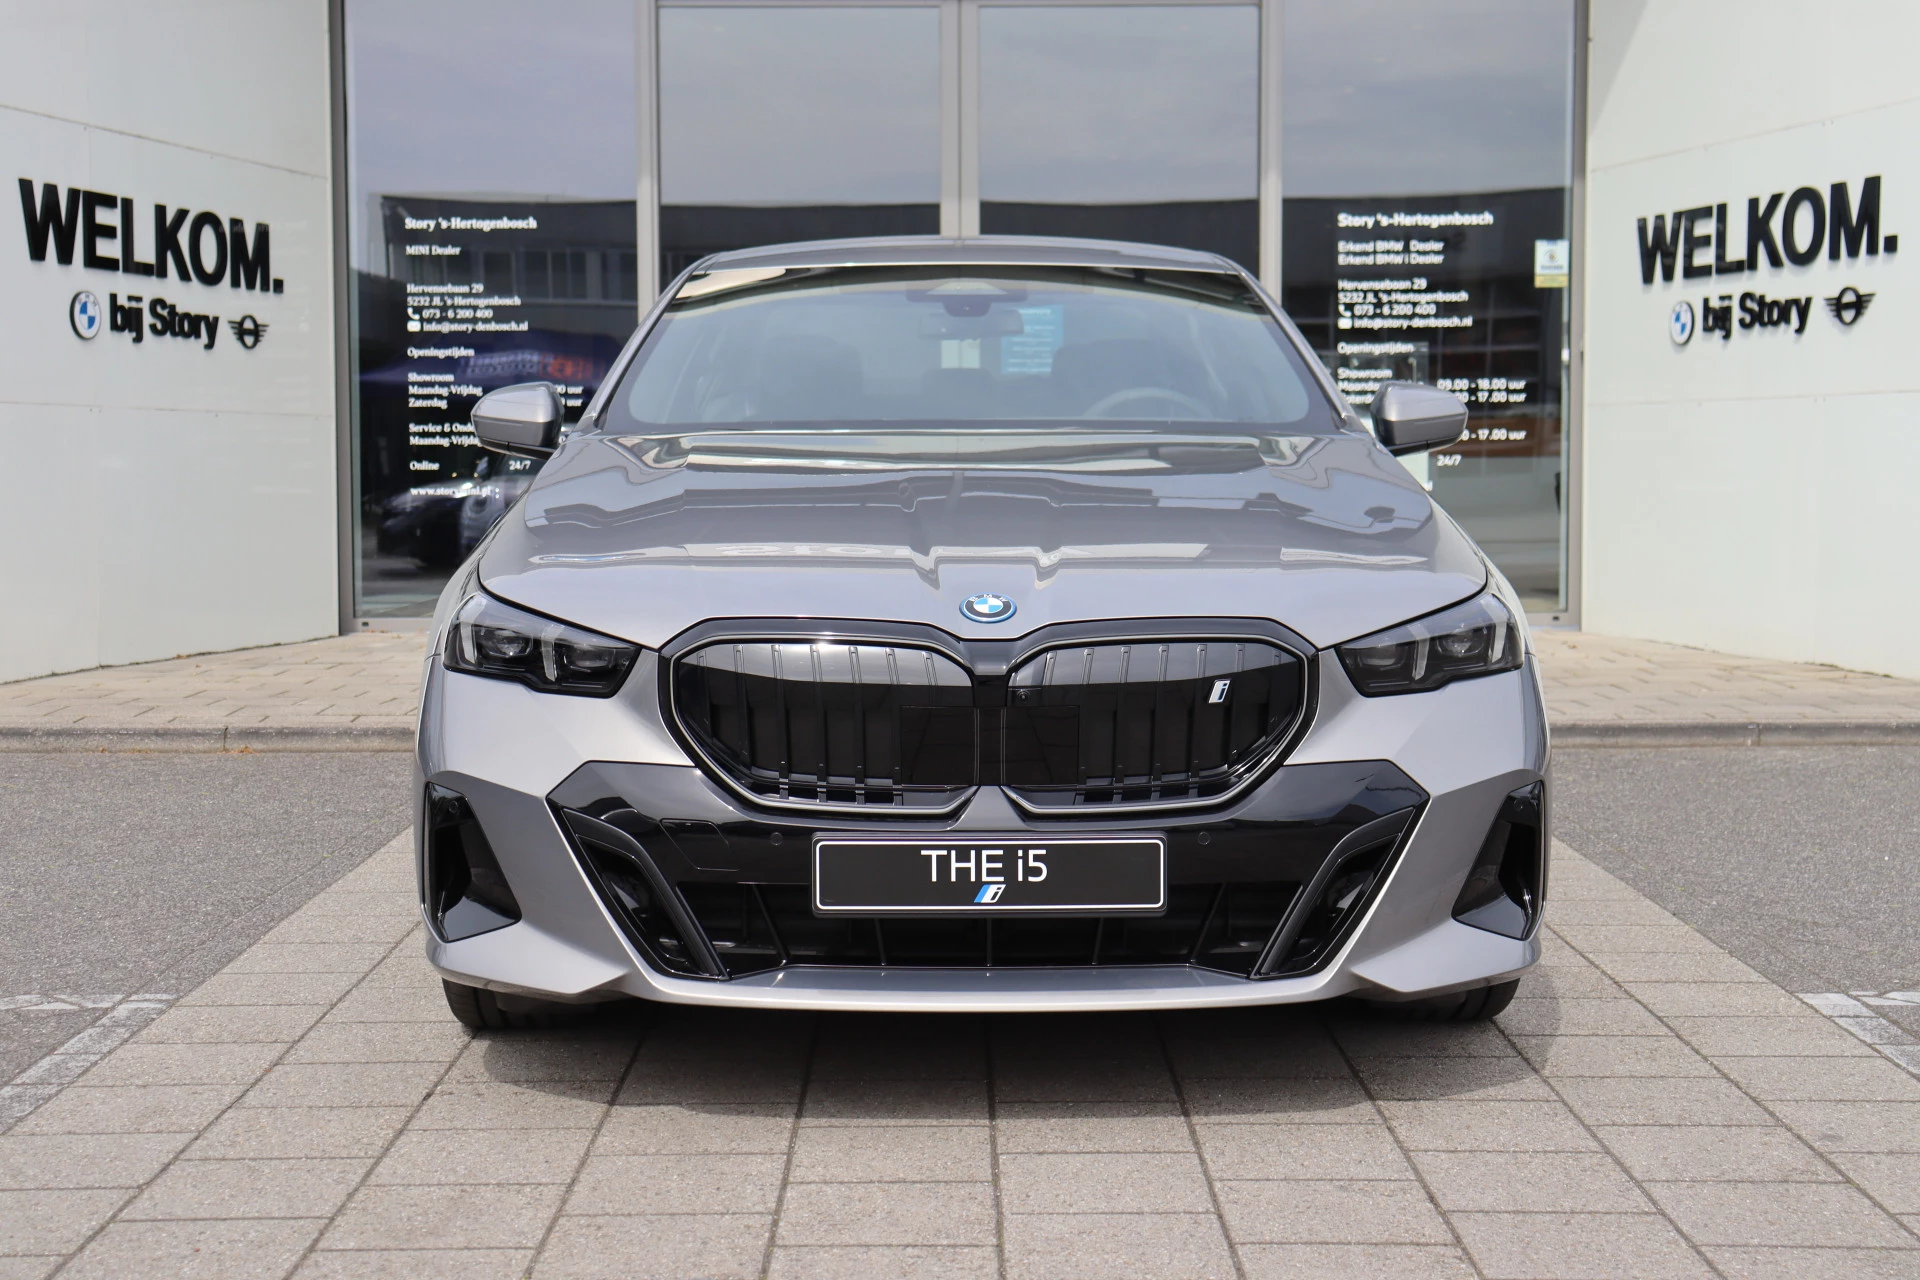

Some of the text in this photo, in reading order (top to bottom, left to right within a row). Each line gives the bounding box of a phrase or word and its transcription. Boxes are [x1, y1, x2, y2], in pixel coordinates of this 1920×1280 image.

[405, 216, 437, 232] Story
[1337, 212, 1375, 229] Story
[18, 177, 284, 294] WELKOM.
[1637, 175, 1898, 285] WELKOM.
[406, 245, 461, 255] MINI Dealer
[1338, 239, 1445, 252] Erkend BMW Dealer
[1338, 253, 1374, 265] Erkend
[1375, 253, 1404, 265] BMW
[1409, 253, 1445, 265] Dealer
[471, 283, 484, 293] 29
[1412, 278, 1427, 290] 29
[406, 296, 431, 306] 5232
[1338, 291, 1364, 303] 5232
[422, 308, 441, 319] 073
[447, 308, 455, 319] 6
[456, 308, 475, 319] 200
[475, 308, 494, 319] 400
[1353, 303, 1374, 315] 073
[1382, 303, 1391, 315] 6
[1391, 303, 1413, 315] 200
[1414, 303, 1436, 315] 400
[1739, 292, 1812, 334] Story
[149, 298, 220, 350] Story
[407, 347, 475, 358] Openingstijden
[1337, 342, 1415, 355] Openingstijden
[408, 372, 455, 382] Showroom
[1337, 367, 1393, 379] Showroom
[409, 385, 483, 397] Maandag-Vrijdag
[1508, 380, 1526, 390] uur
[408, 397, 448, 409] Zaterdag
[1477, 391, 1507, 403] 17.00
[1508, 392, 1526, 403] uur
[409, 422, 443, 432] Service
[443, 422, 451, 432] &
[1477, 428, 1507, 441] 17.00
[1508, 430, 1526, 440] uur
[409, 460, 441, 471] Online
[509, 460, 531, 470] 24/7
[1436, 454, 1462, 467] 24/7
[920, 849, 1048, 883] THE i5
